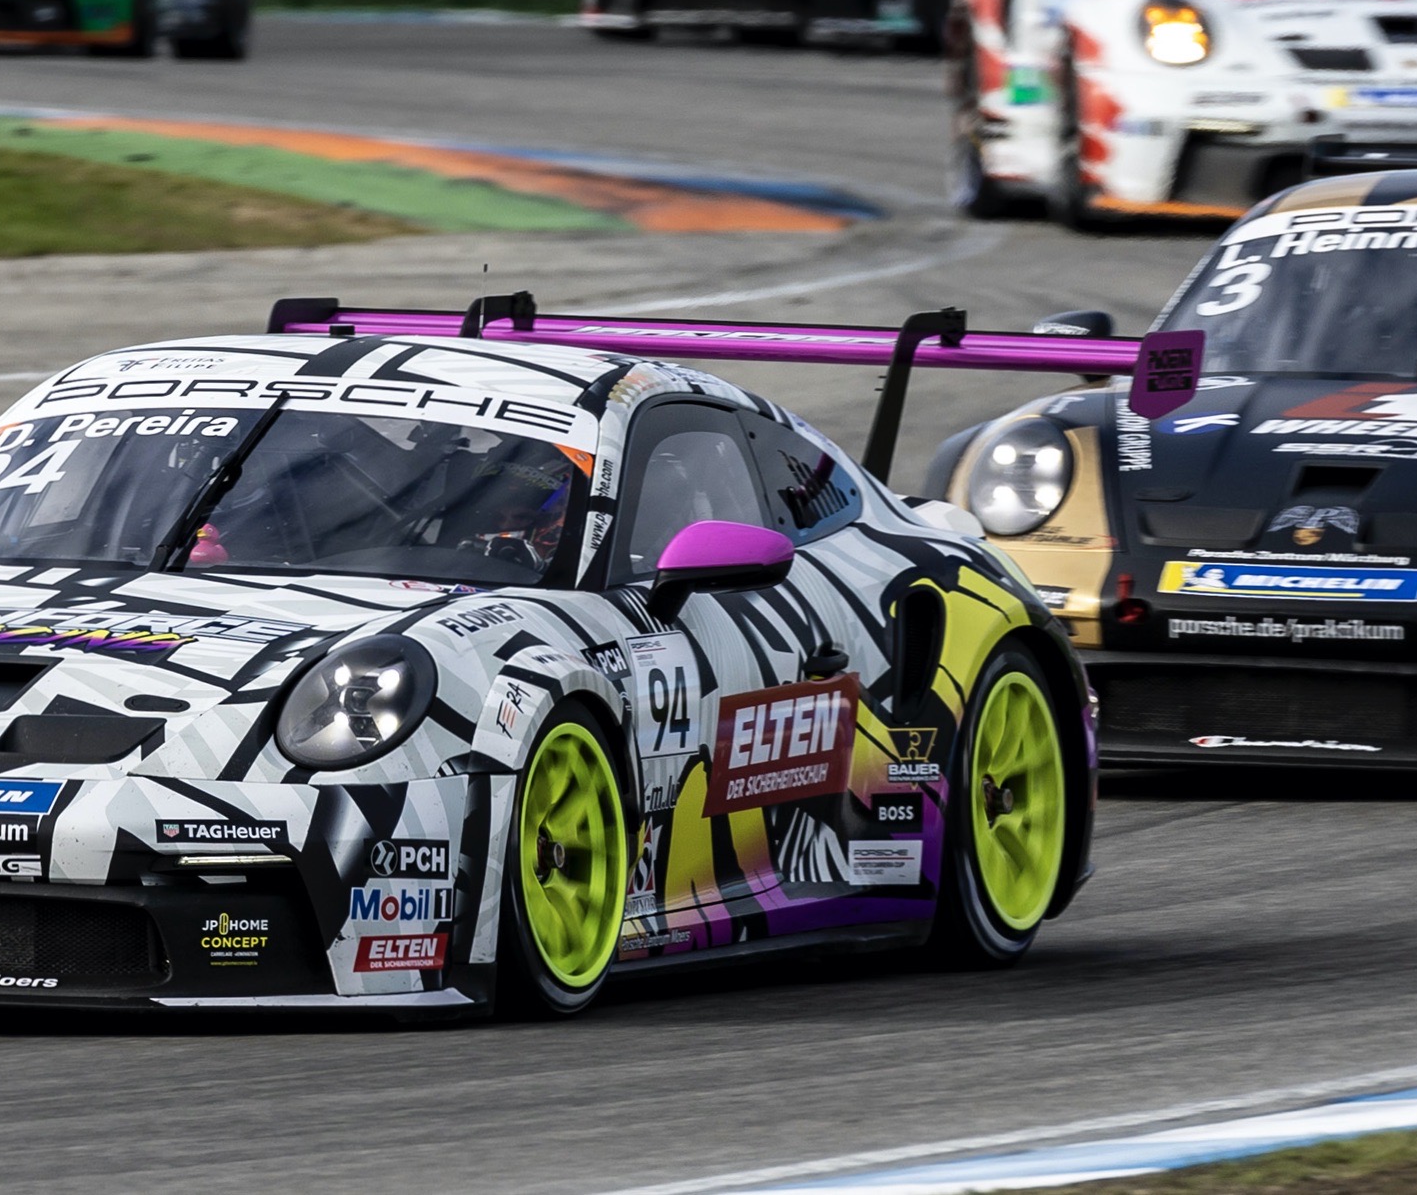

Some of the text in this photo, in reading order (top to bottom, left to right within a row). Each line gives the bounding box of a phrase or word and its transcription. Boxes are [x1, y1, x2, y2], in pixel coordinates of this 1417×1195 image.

[1195, 262, 1273, 317] 3
[34, 378, 578, 435] PORSCHE
[47, 408, 240, 444] Pereira
[435, 602, 525, 638] FLOWEY
[597, 647, 628, 676] PCH
[647, 666, 691, 752] 94
[728, 690, 842, 770] ELTEN
[887, 763, 941, 776] BAUER
[726, 780, 746, 801] DER
[878, 805, 915, 821] BOSS
[184, 822, 282, 841] TAGHeuer
[399, 845, 446, 873] PCH
[349, 888, 430, 922] Mobil
[201, 919, 269, 931] JP HOME
[200, 936, 269, 948] CONCEPT
[368, 937, 439, 960] ELTEN
